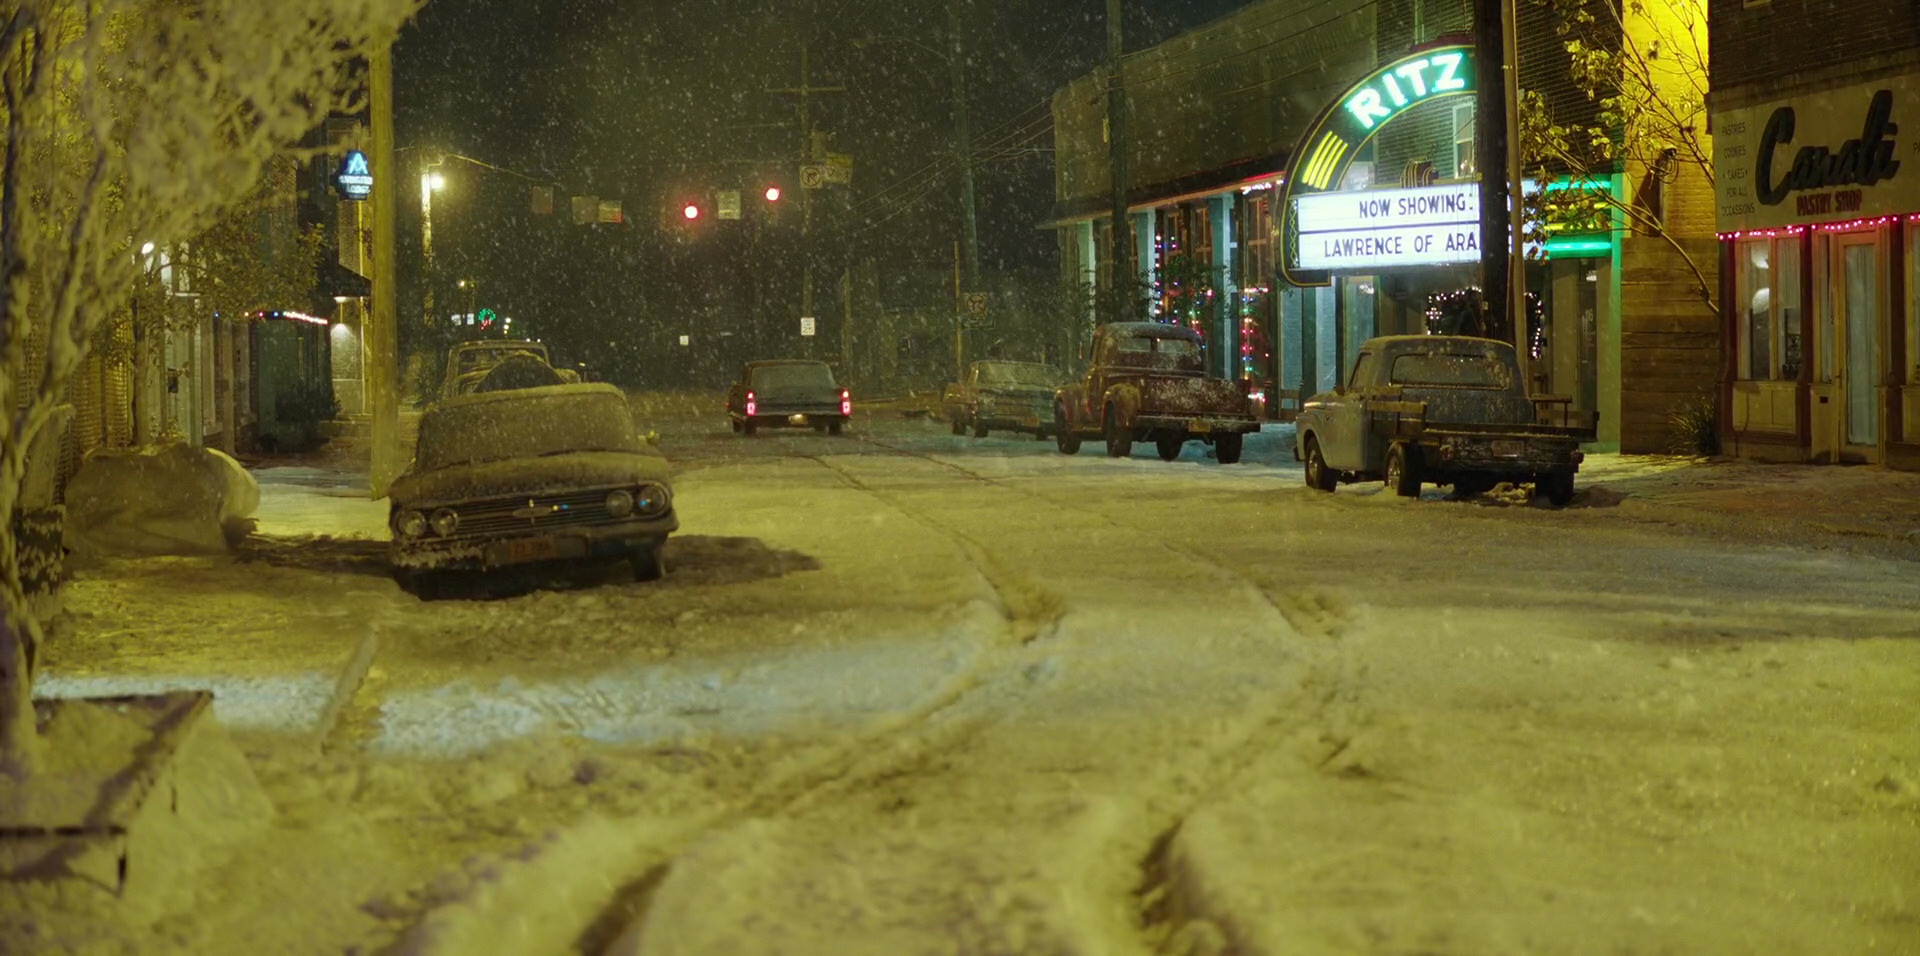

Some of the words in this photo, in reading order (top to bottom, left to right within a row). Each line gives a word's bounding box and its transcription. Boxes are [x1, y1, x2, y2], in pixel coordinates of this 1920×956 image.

[1344, 52, 1464, 129] RITZ
[1359, 199, 1391, 218] NOW
[1399, 193, 1474, 215] SHOWING:
[1797, 193, 1831, 216] PASTRY
[1835, 189, 1862, 212] SHOP
[1324, 236, 1403, 258] LAWRENCE
[1414, 234, 1433, 253] OF
[1445, 231, 1479, 252] ARA
